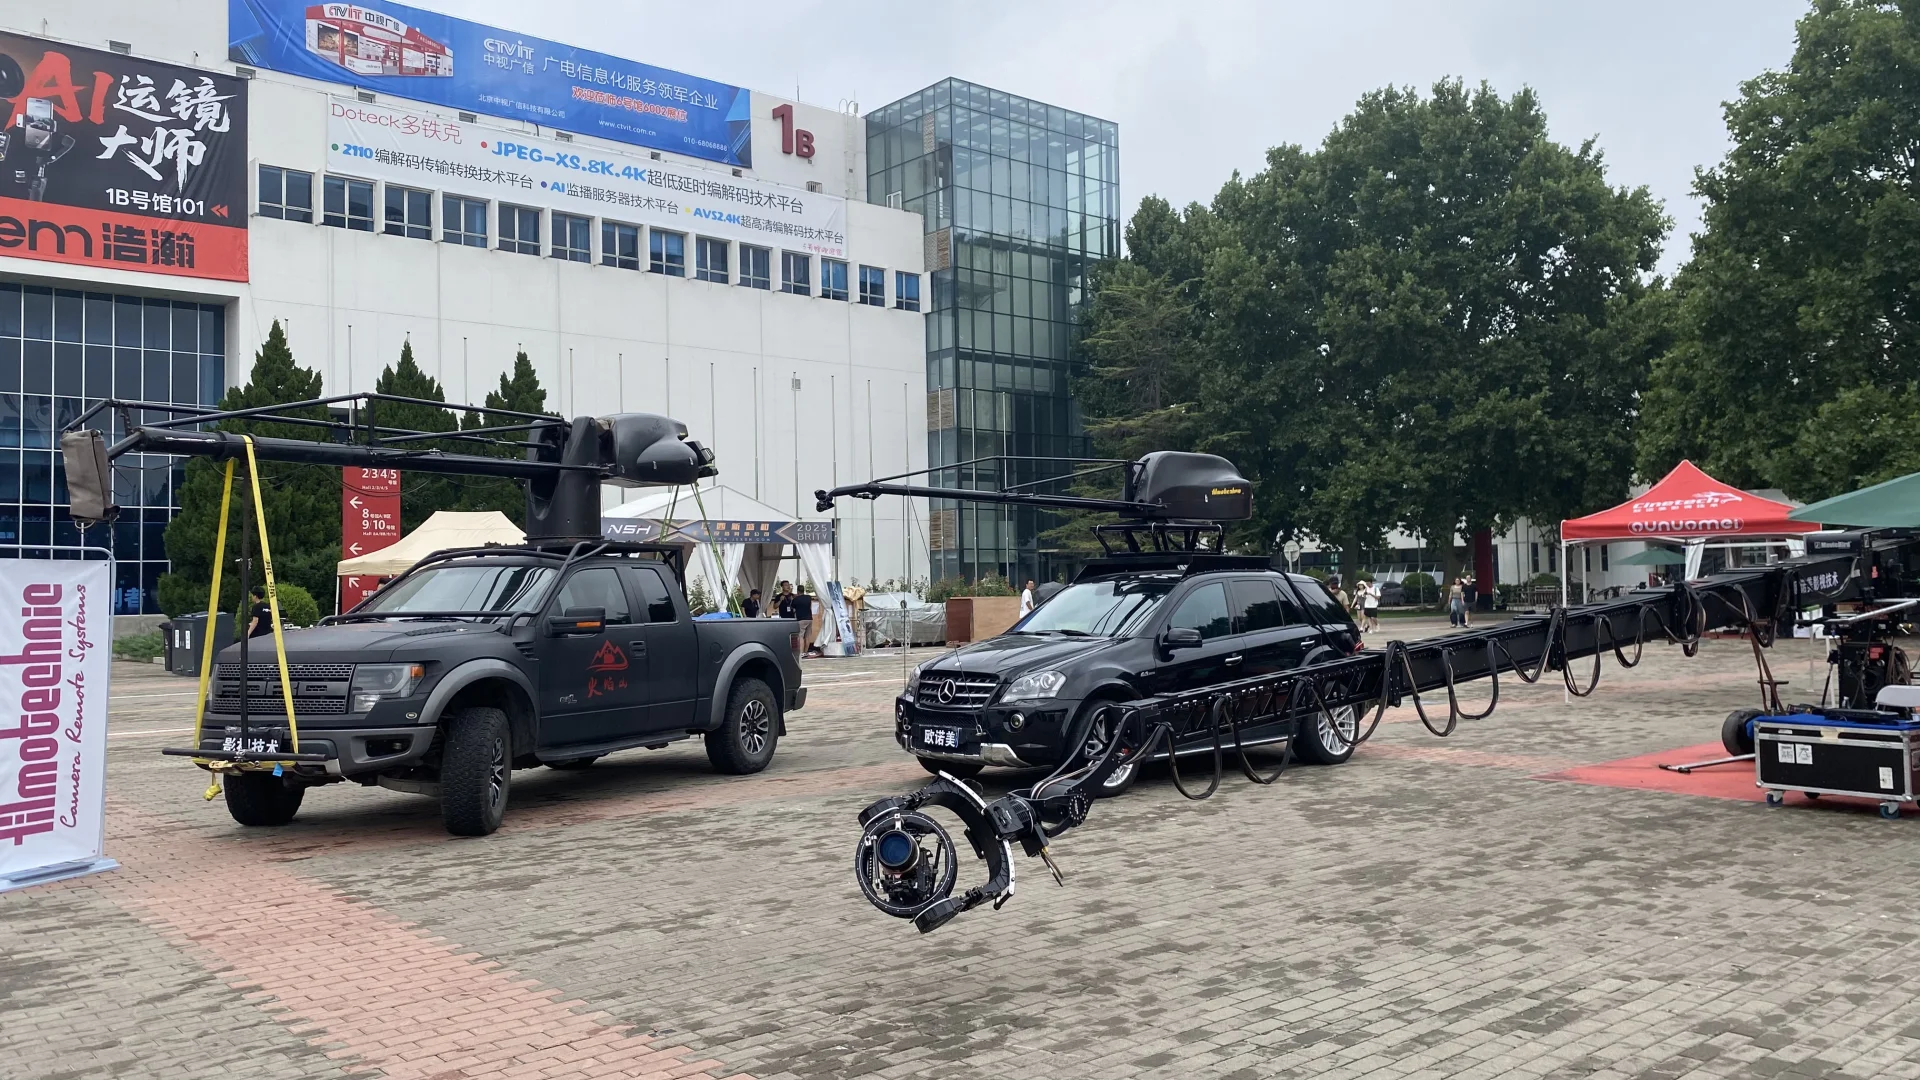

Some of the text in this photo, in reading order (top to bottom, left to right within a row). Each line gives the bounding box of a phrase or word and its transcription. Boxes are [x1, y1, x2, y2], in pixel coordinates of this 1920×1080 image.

[483, 53, 535, 75] 中视广信
[543, 56, 719, 110] 广电信息化服务领军企业
[478, 93, 566, 119] 北京中视广信科技有限公司
[598, 119, 657, 137] www.ctvit.com.cn
[96, 125, 207, 193] 大师
[106, 188, 204, 216] 1B号馆101
[102, 222, 195, 269] 浩瀚
[362, 468, 397, 479] 2/3/4/5
[607, 524, 652, 535] NSH
[797, 523, 828, 532] 2025
[60, 584, 94, 828] Camera Remote Systems
[924, 729, 956, 748] 欧诺美
